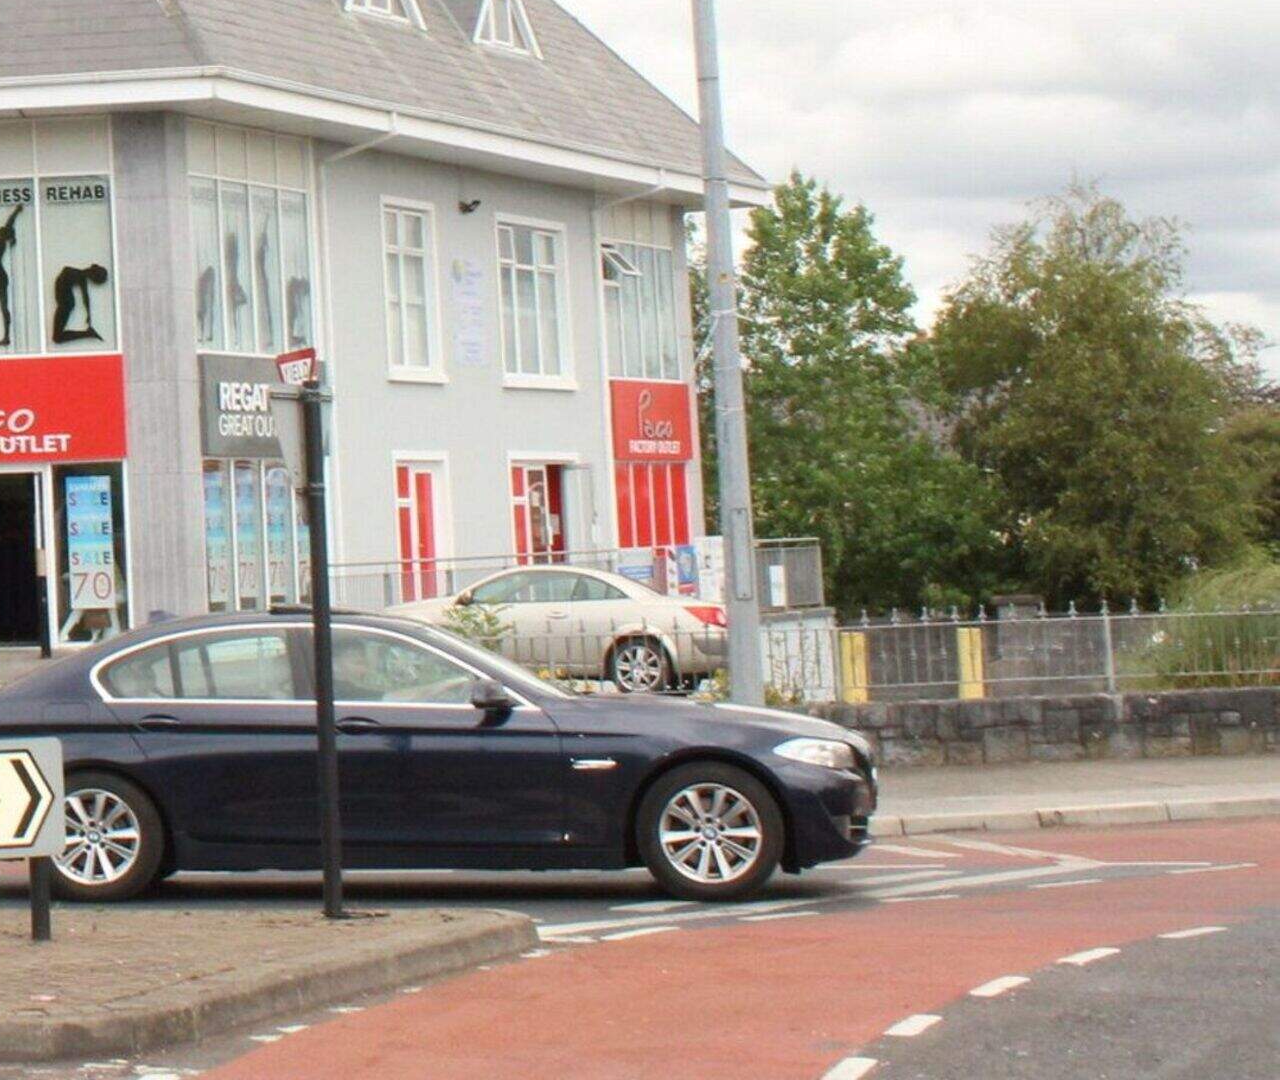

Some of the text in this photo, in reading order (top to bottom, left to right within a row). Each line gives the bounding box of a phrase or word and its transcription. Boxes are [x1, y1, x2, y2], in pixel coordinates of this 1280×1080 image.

[46, 185, 105, 201] REHAB
[219, 382, 269, 412] REGAT
[219, 414, 274, 438] GREAT OU
